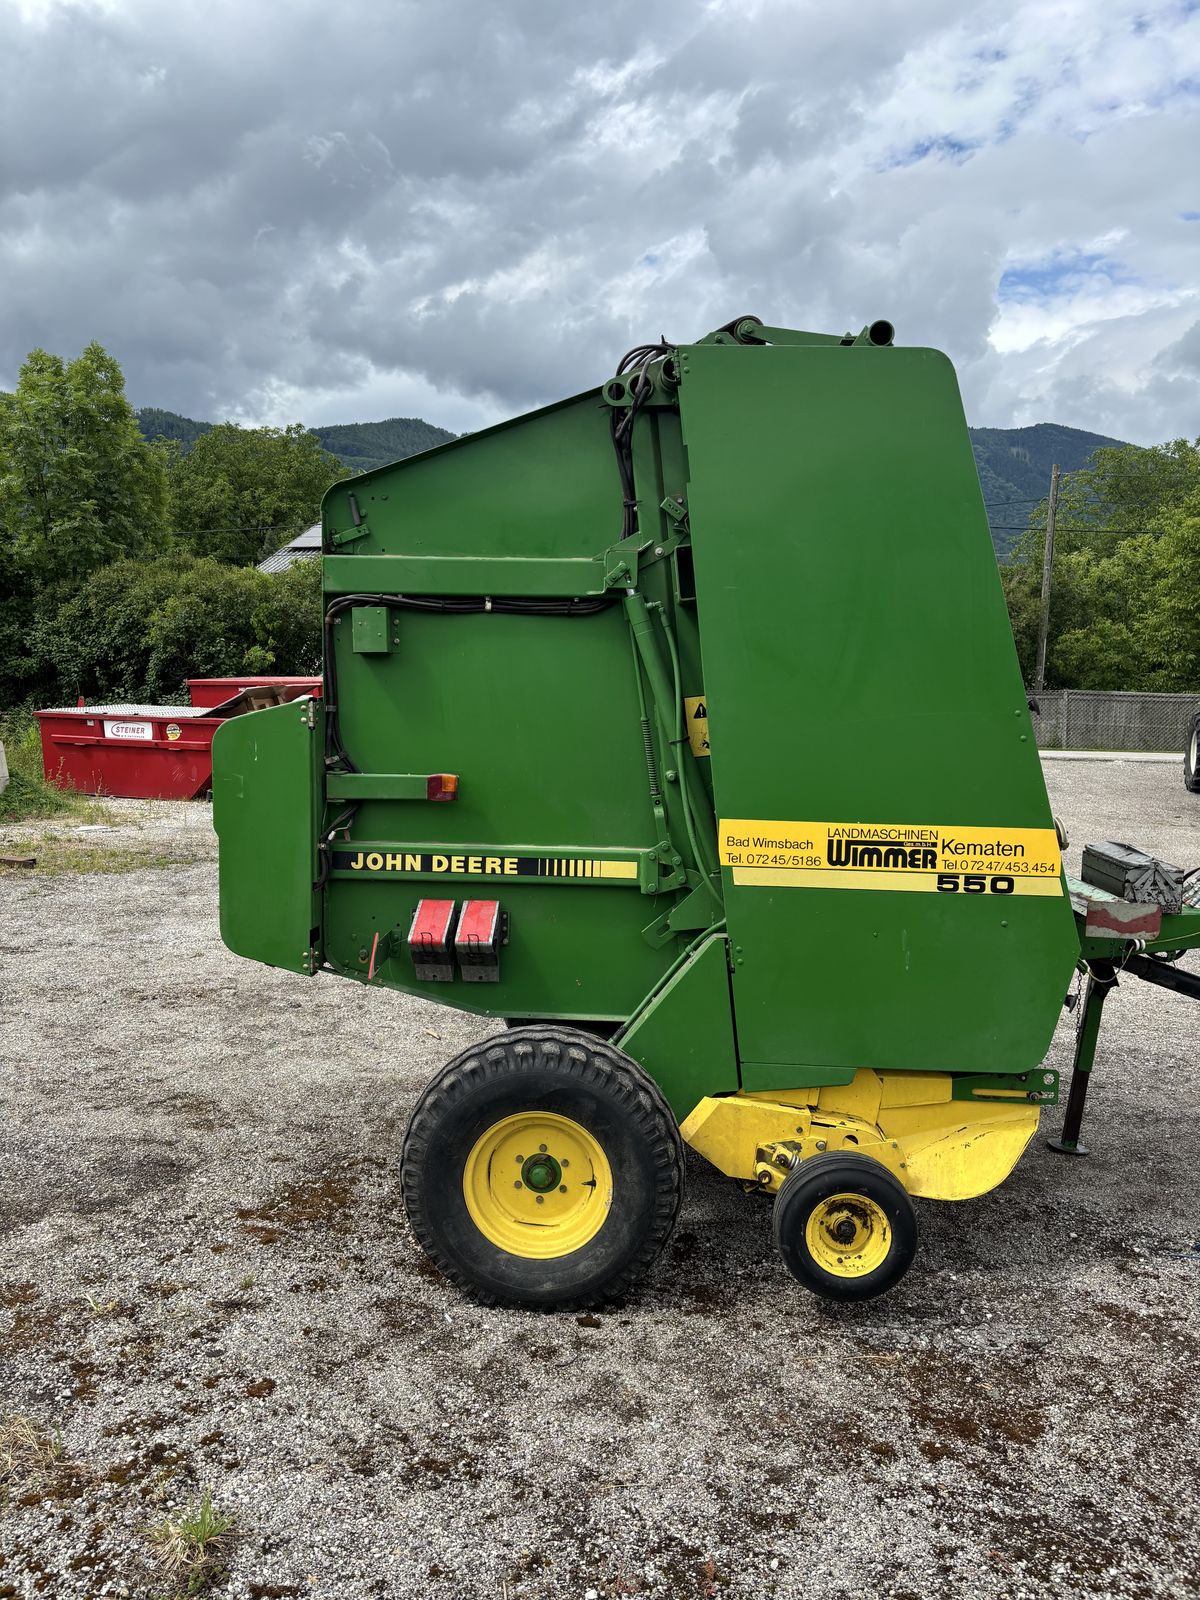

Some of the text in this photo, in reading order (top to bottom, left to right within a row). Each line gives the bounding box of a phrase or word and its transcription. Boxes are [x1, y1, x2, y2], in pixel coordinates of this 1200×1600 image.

[115, 726, 145, 735] STEINER
[827, 827, 939, 841] LANDMASCHINEN
[726, 836, 814, 850] Bad Wimsbach
[941, 838, 1025, 857] Kematen
[350, 852, 519, 875] JOHN DEERE
[936, 874, 1015, 894] 550
